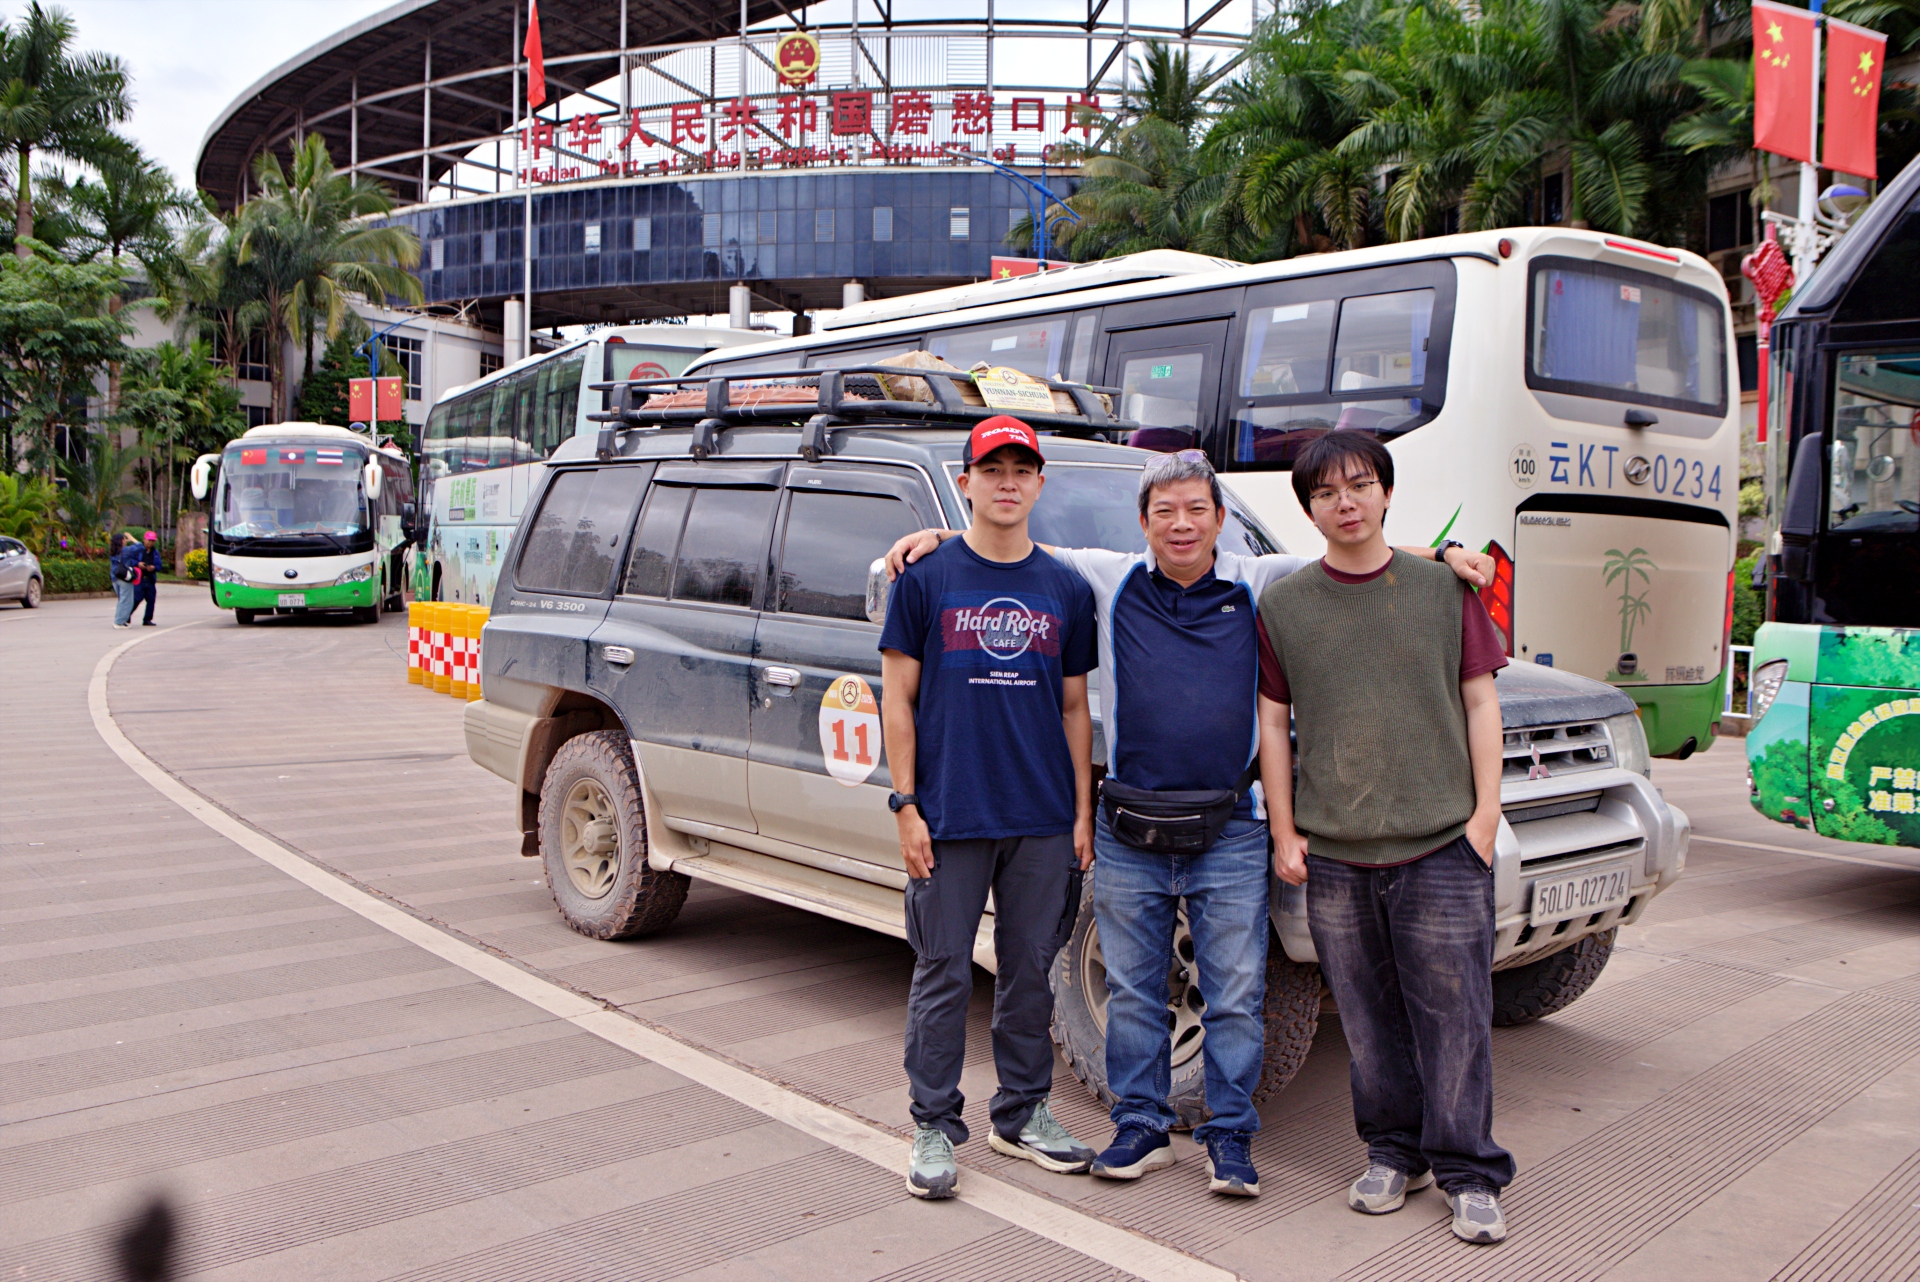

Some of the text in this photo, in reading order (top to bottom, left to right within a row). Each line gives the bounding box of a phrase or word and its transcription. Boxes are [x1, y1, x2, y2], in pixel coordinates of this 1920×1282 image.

[522, 90, 1101, 160] 中华人民共和国磨憨口岸
[522, 165, 580, 184] Mohan
[600, 158, 639, 175] Port
[658, 154, 682, 171] of
[703, 150, 741, 168] The
[759, 144, 849, 166] People's
[993, 143, 1017, 162] of
[983, 387, 1049, 400] YUNNAN-SICHUAN
[1514, 458, 1535, 475] 100
[1654, 454, 1721, 502] 0234
[540, 600, 554, 610] V6
[556, 601, 586, 612] 3500
[955, 609, 1050, 640] Hard Rock
[993, 639, 1017, 648] CAFE
[968, 678, 1037, 687] INTERNATIONAL AIRPORT
[1003, 671, 1019, 679] REAP
[832, 719, 872, 766] 11
[1589, 746, 1607, 760] V6
[1868, 766, 1920, 791] 严禁
[1868, 790, 1920, 814] 准乘
[1538, 871, 1625, 917] 50LD-027.24
